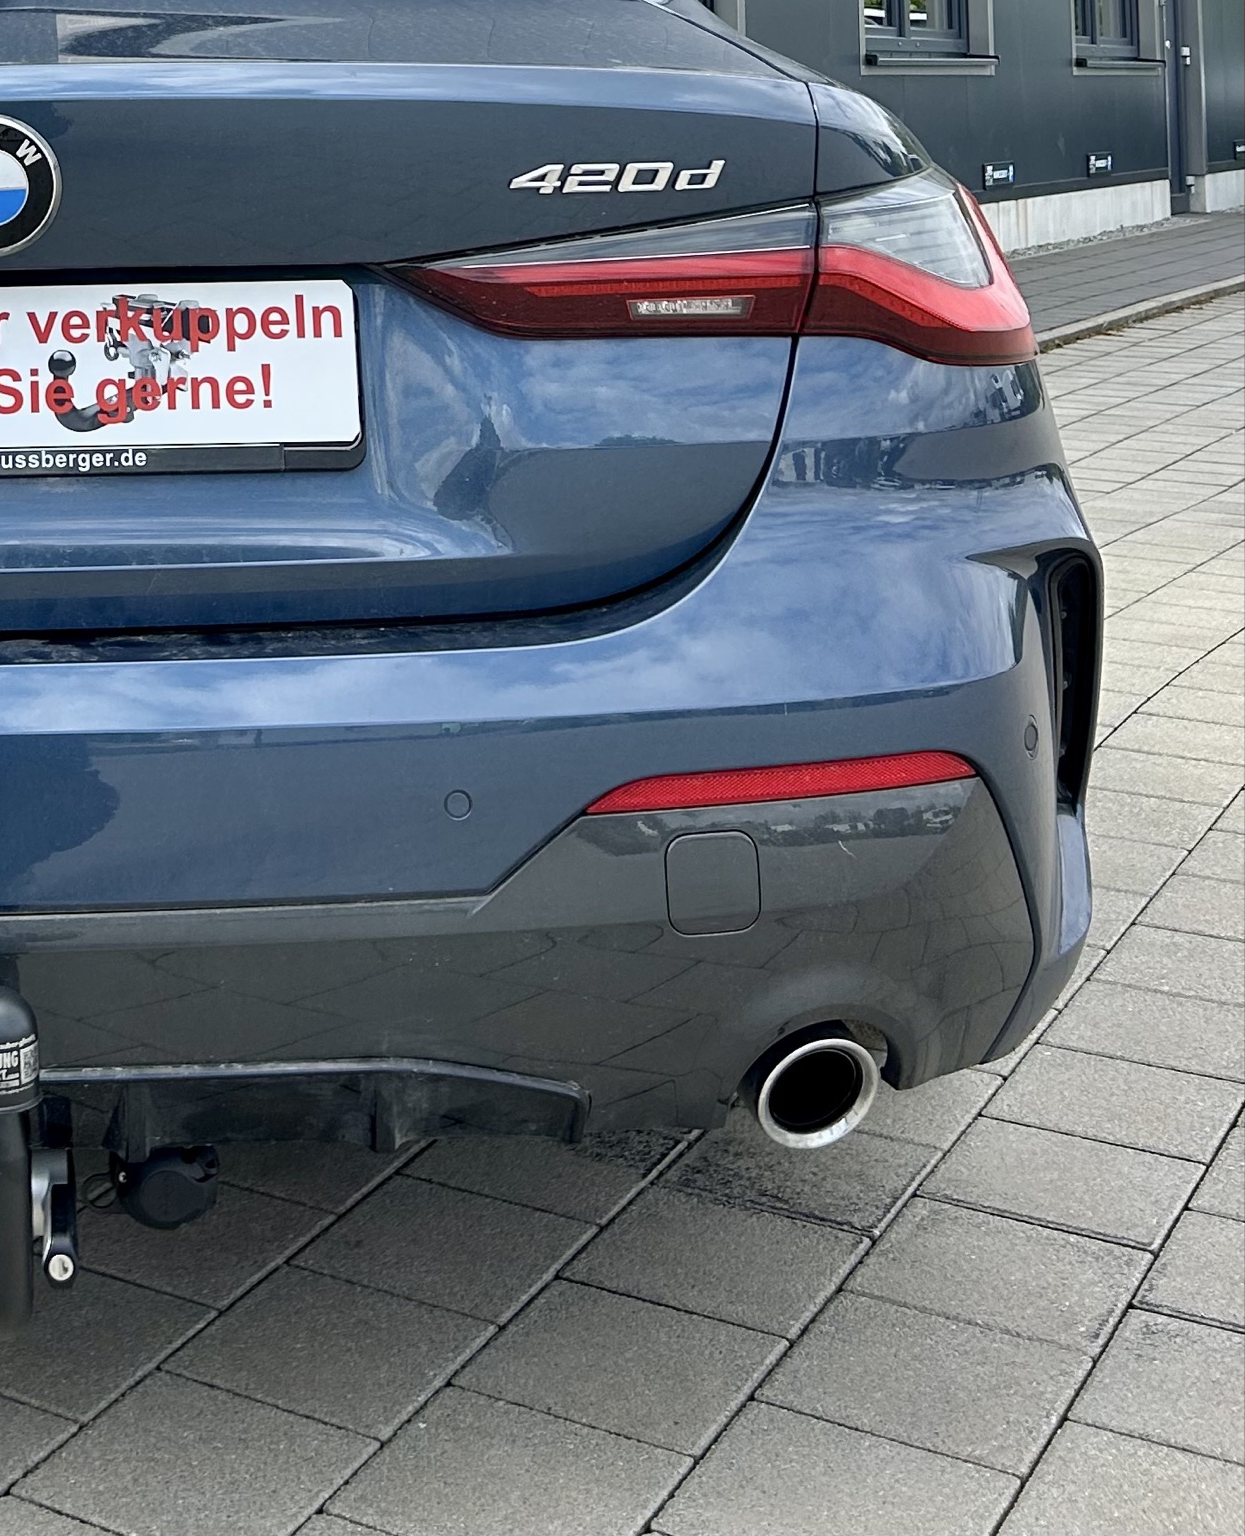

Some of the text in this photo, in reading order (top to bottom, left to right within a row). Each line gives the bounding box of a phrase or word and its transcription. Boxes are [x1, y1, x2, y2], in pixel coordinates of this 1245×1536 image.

[509, 159, 726, 194] 420d
[26, 294, 343, 353] verkuppeln
[96, 363, 273, 424] gerne!
